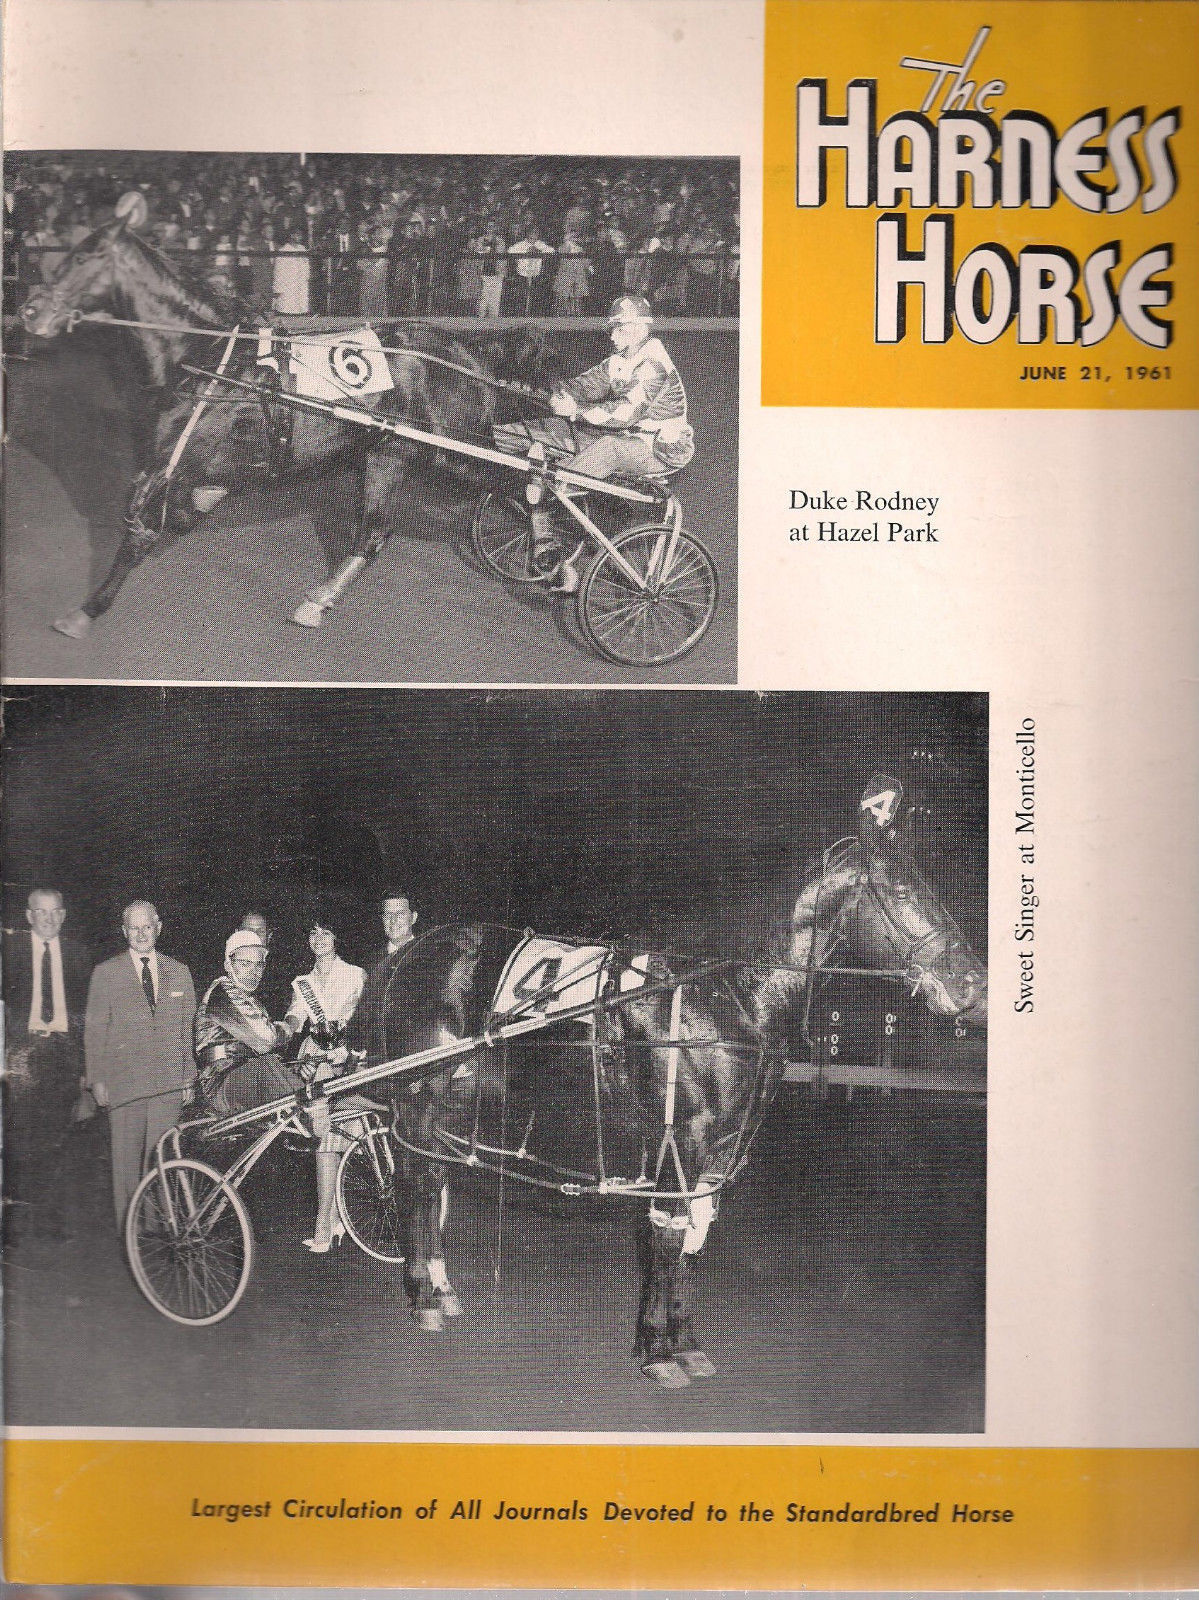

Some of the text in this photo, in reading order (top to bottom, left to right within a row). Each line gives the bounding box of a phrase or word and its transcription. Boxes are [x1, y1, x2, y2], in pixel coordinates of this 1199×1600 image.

[900, 26, 1006, 113] The
[796, 78, 1181, 213] HARNESS
[875, 213, 1175, 348] HORSE
[328, 339, 373, 390] 6
[1019, 366, 1172, 382] JUNE 21, 1961
[789, 490, 939, 516] Duke Rodney
[789, 521, 939, 542] at Hazel Park
[860, 790, 896, 828] 4
[1014, 717, 1040, 1013] Sweet Singer at Monticello
[512, 957, 562, 1012] 4
[191, 1498, 1014, 1523] Largest Circulation of All Journals Devoted to the Standardbred Horse
